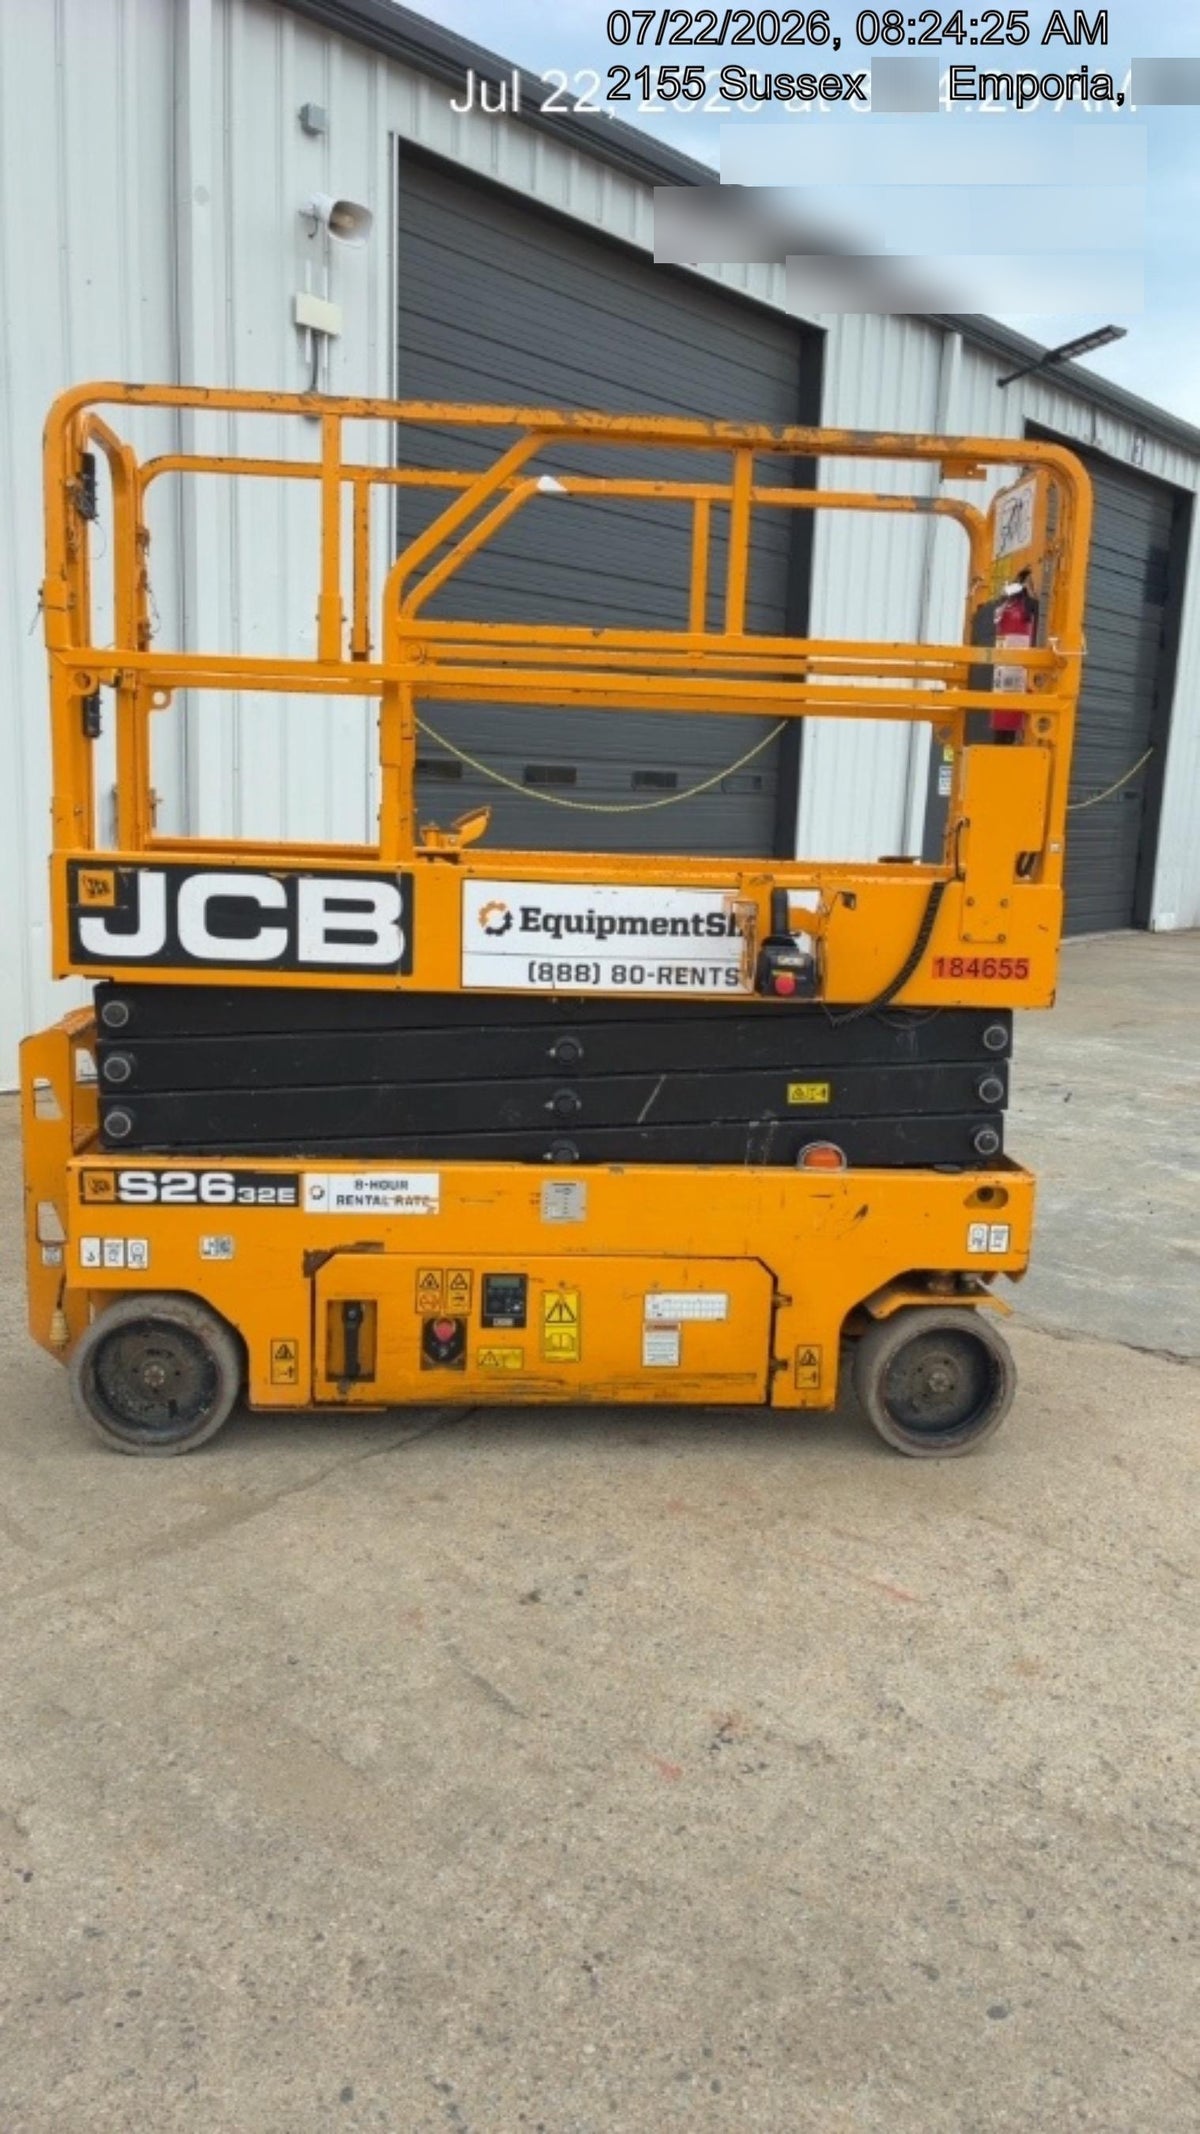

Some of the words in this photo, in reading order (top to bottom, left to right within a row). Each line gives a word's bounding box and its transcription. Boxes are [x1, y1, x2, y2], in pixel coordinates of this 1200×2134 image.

[78, 871, 405, 965] JCB
[527, 960, 601, 984] (888)
[611, 963, 740, 987] 80-RENTS
[934, 957, 1030, 980] 184655
[355, 1179, 409, 1191] 8-HOUR
[336, 1194, 389, 1207] RENTAL
